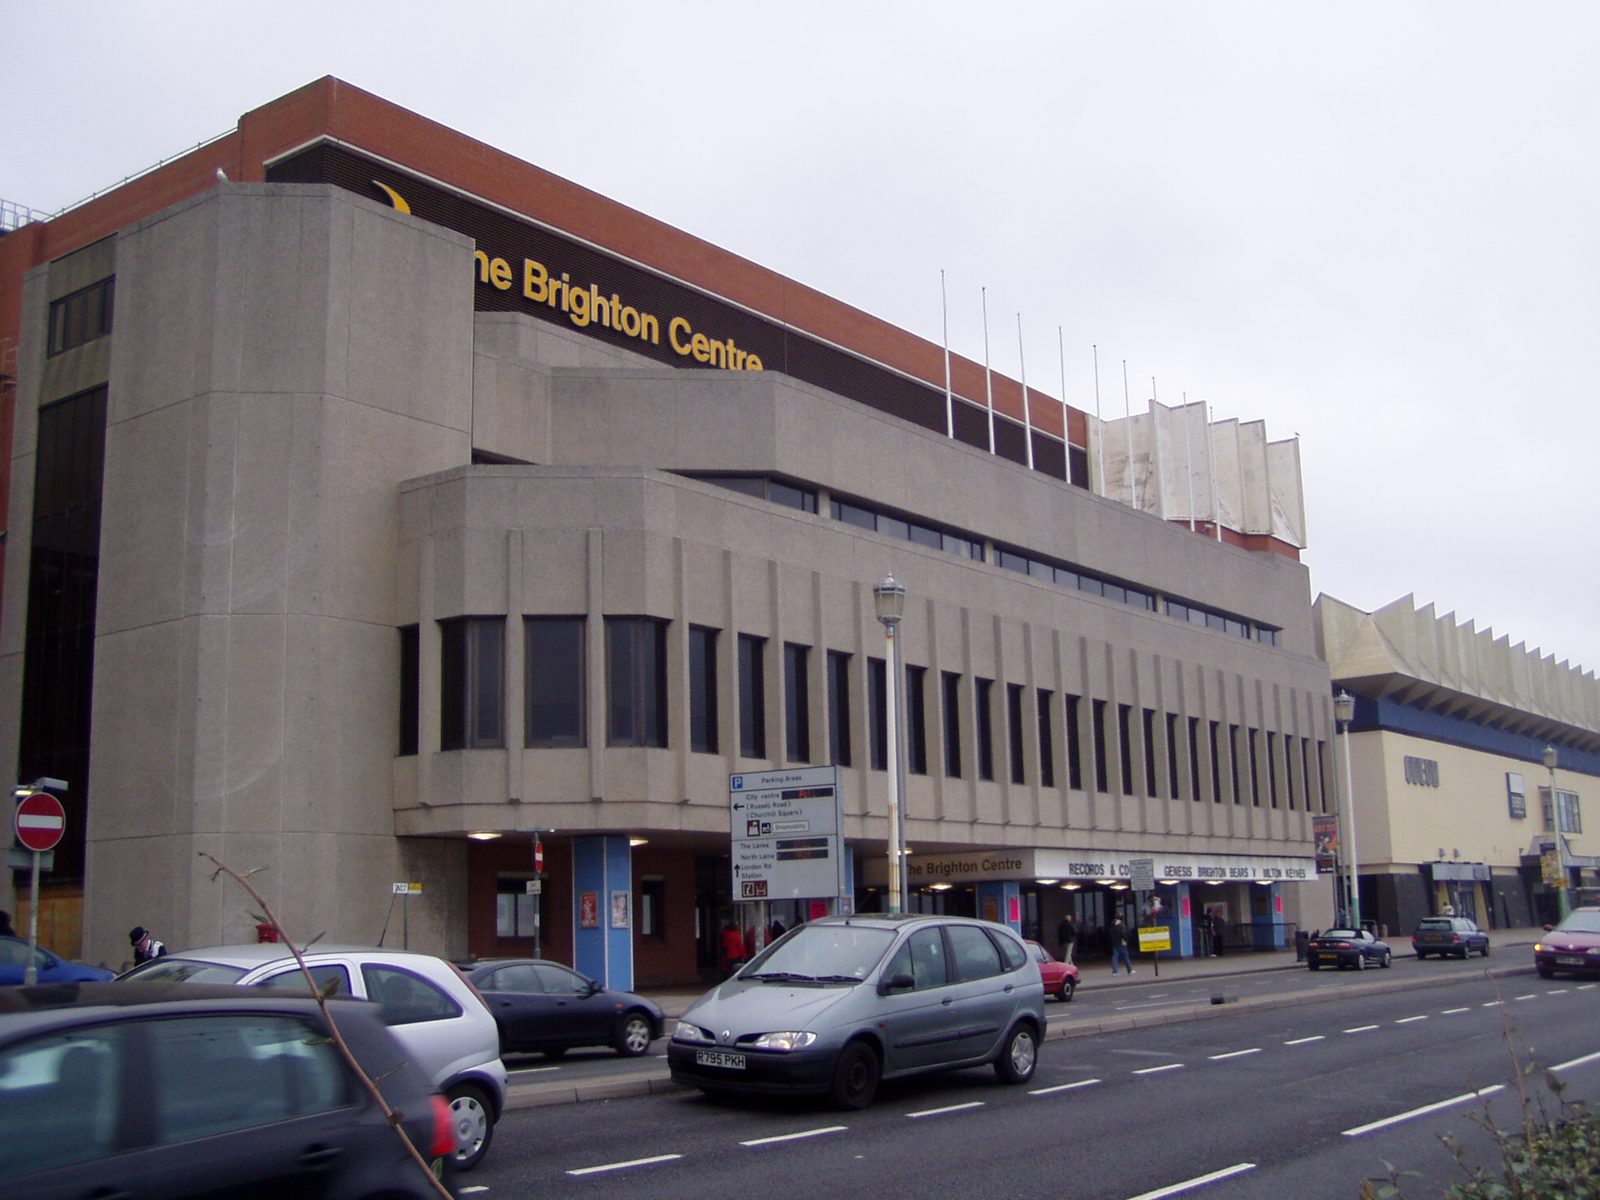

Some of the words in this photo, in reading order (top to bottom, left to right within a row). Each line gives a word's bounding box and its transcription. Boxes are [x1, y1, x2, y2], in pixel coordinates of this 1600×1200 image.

[523, 257, 659, 345] Brighton
[668, 316, 764, 371] Centre
[778, 809, 803, 817] Square)
[906, 863, 923, 876] The
[927, 862, 978, 877] Brighton
[982, 858, 1022, 872] Centre
[1069, 863, 1105, 875] RECORDS
[1110, 864, 1115, 875] &
[1164, 866, 1192, 877] GENESIS
[1198, 866, 1226, 877] BRIGHTON
[1230, 867, 1249, 877] BEARS
[1263, 868, 1281, 878] MILTON
[1286, 869, 1306, 878] KEYNES
[698, 1052, 722, 1065] R795
[725, 1054, 745, 1067] PKH
